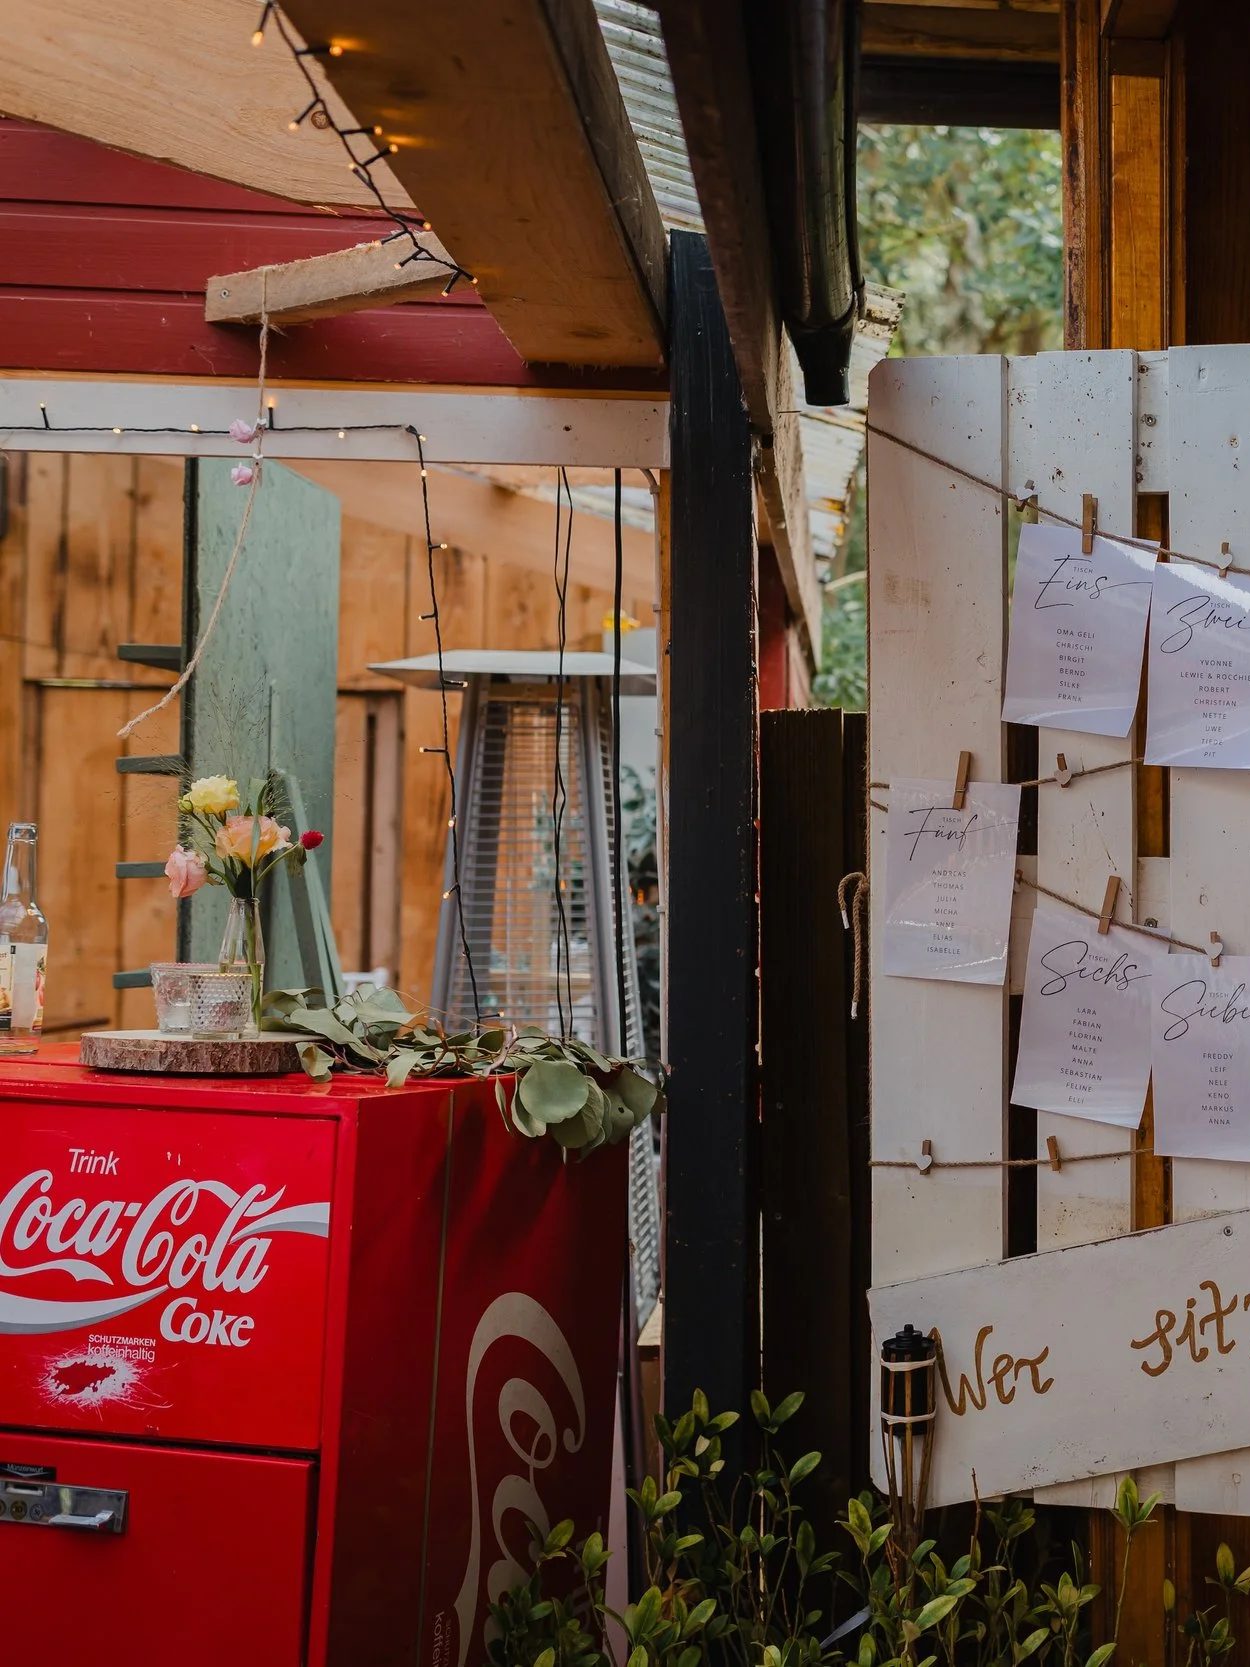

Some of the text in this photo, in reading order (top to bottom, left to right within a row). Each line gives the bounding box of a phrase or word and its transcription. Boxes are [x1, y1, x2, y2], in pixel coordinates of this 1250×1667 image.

[1073, 566, 1093, 574] TISCH
[1034, 554, 1153, 610] Eins
[1056, 628, 1095, 639] OMA GELI
[1059, 655, 1085, 664] BIRGIT
[1200, 659, 1233, 667] YVONNE
[1059, 668, 1085, 677] BERND
[1059, 680, 1081, 689] SILKE
[1057, 693, 1082, 702] FRANK
[1194, 699, 1237, 707] CHRISTIAN
[1202, 712, 1227, 720] NETTE
[903, 806, 1019, 861] Fünf
[933, 882, 964, 890] THOMAS
[927, 947, 961, 955] ISABELLE
[1088, 954, 1109, 963] TISCH
[1040, 940, 1153, 996] Sechs
[1077, 1007, 1097, 1016] LARA
[1072, 1019, 1102, 1029] FABIAN
[1069, 1031, 1103, 1042] FLORIAN
[1072, 1044, 1097, 1054] MALTE
[1072, 1057, 1094, 1066] ANNA
[1060, 1068, 1103, 1081] SEBASTIAN
[1066, 1082, 1092, 1092] FELINE
[1068, 1096, 1085, 1104] ELLI
[69, 1148, 120, 1175] Trink
[0, 1169, 286, 1293] Coca-Cola
[159, 1296, 255, 1347] Coke
[88, 1334, 156, 1346] SCHUTZMARKEN
[87, 1343, 155, 1362] koffeinhaltig
[927, 1325, 1054, 1417] Wer
